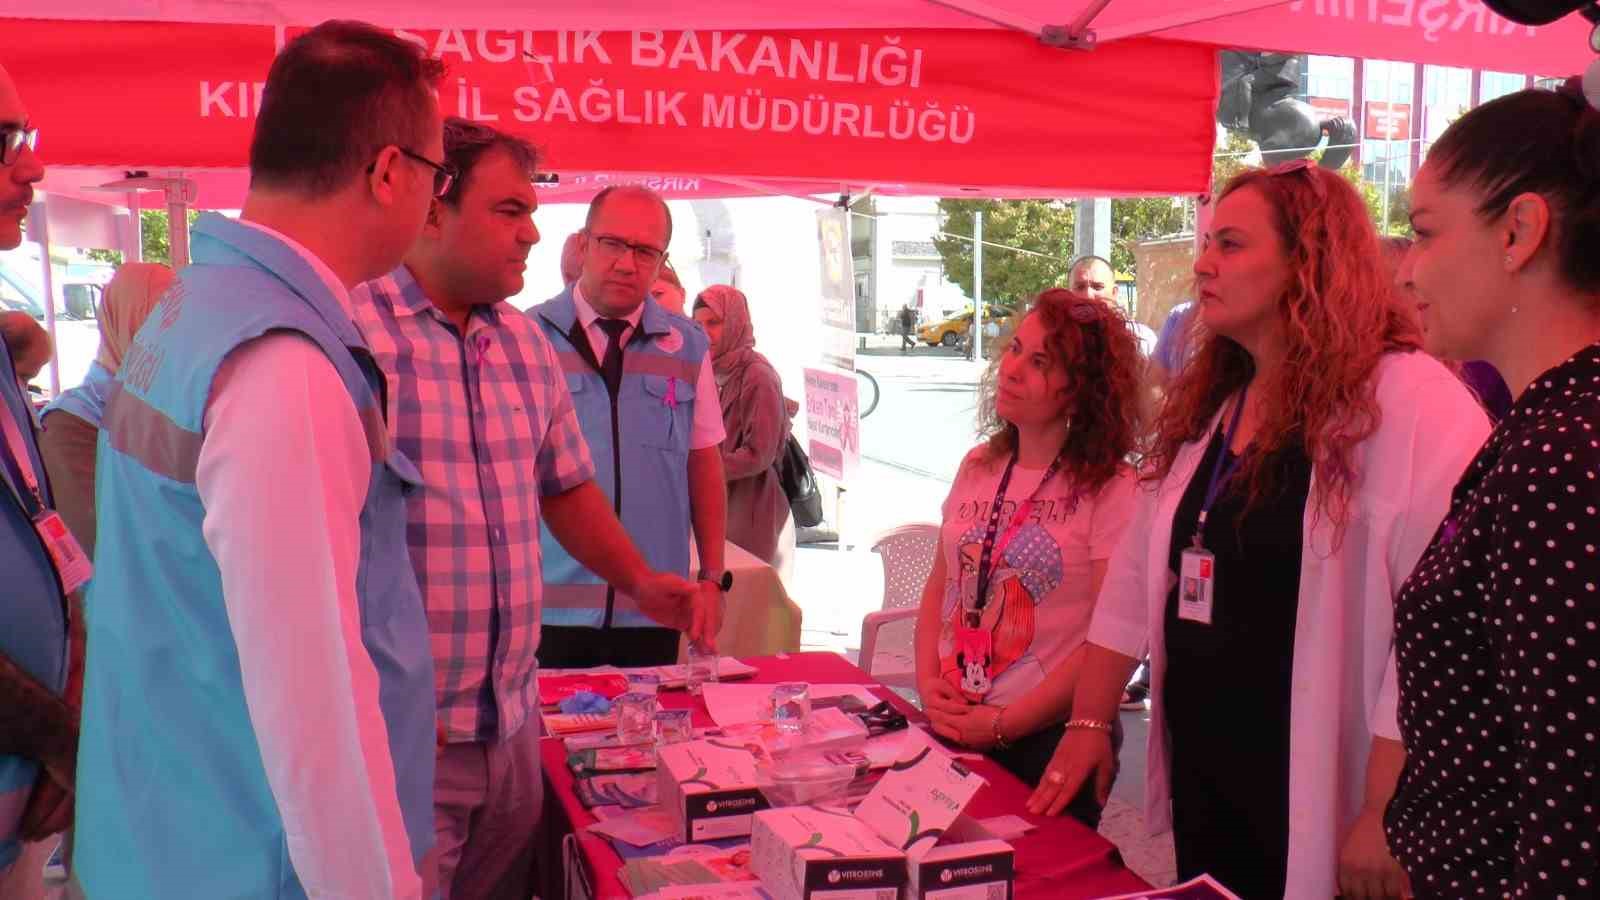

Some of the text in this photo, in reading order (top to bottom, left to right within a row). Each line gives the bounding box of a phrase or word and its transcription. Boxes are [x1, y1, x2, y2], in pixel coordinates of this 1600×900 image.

[632, 30, 922, 88] BAKANLIĞI
[457, 77, 976, 144] İL SAĞLIK MÜDÜRLÜĞÜ
